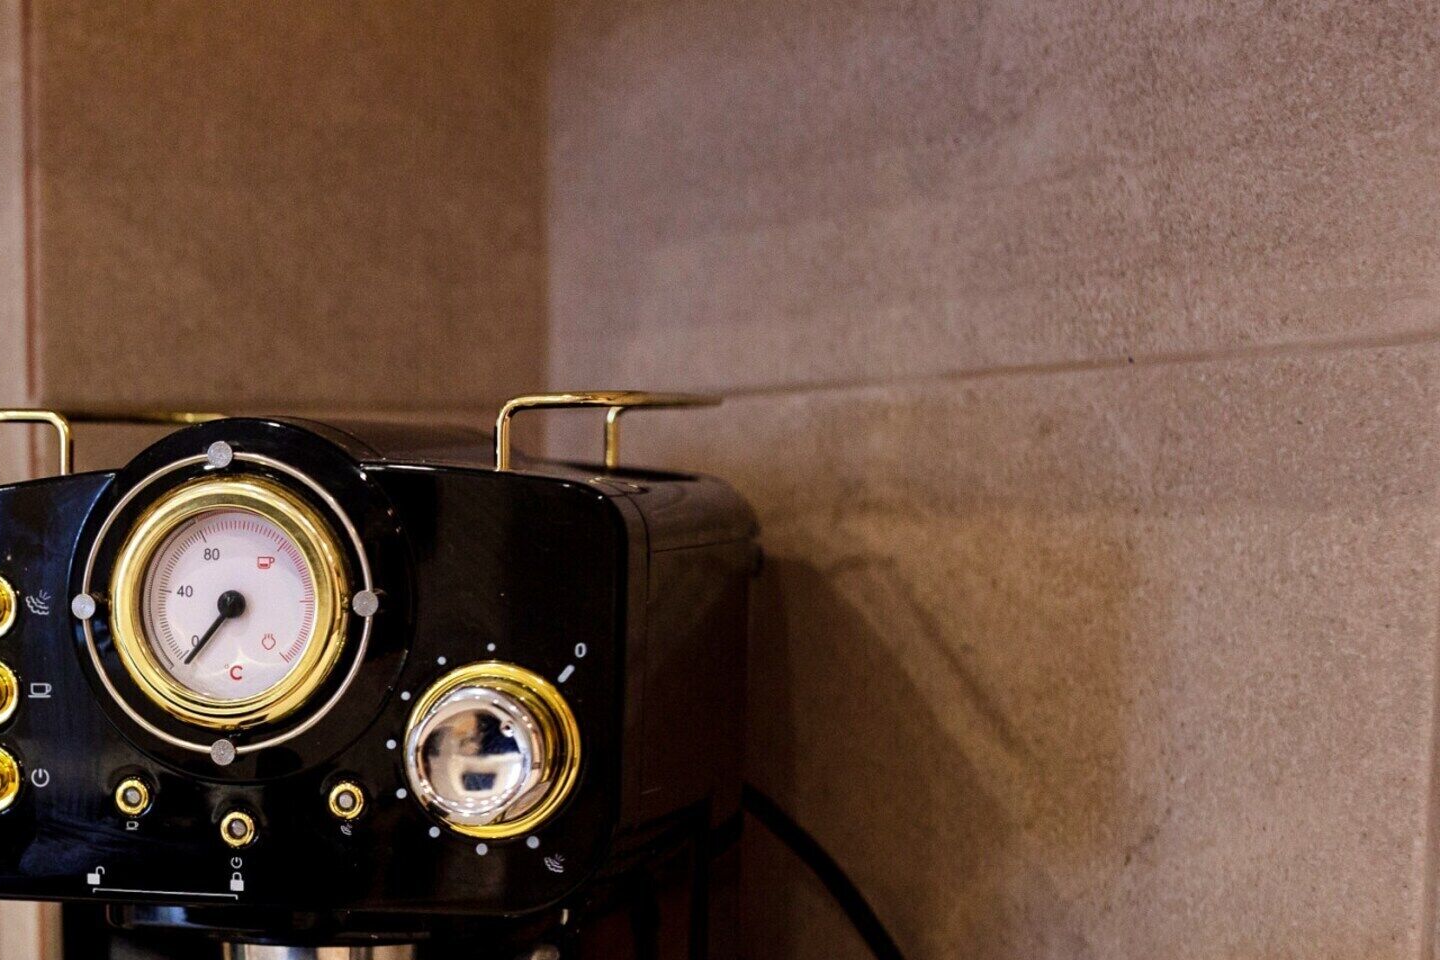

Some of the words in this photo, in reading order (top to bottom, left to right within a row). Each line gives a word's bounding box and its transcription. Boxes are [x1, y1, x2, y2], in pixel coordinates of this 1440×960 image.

[203, 548, 220, 561] 80
[177, 585, 193, 597] 40
[191, 634, 200, 648] 0
